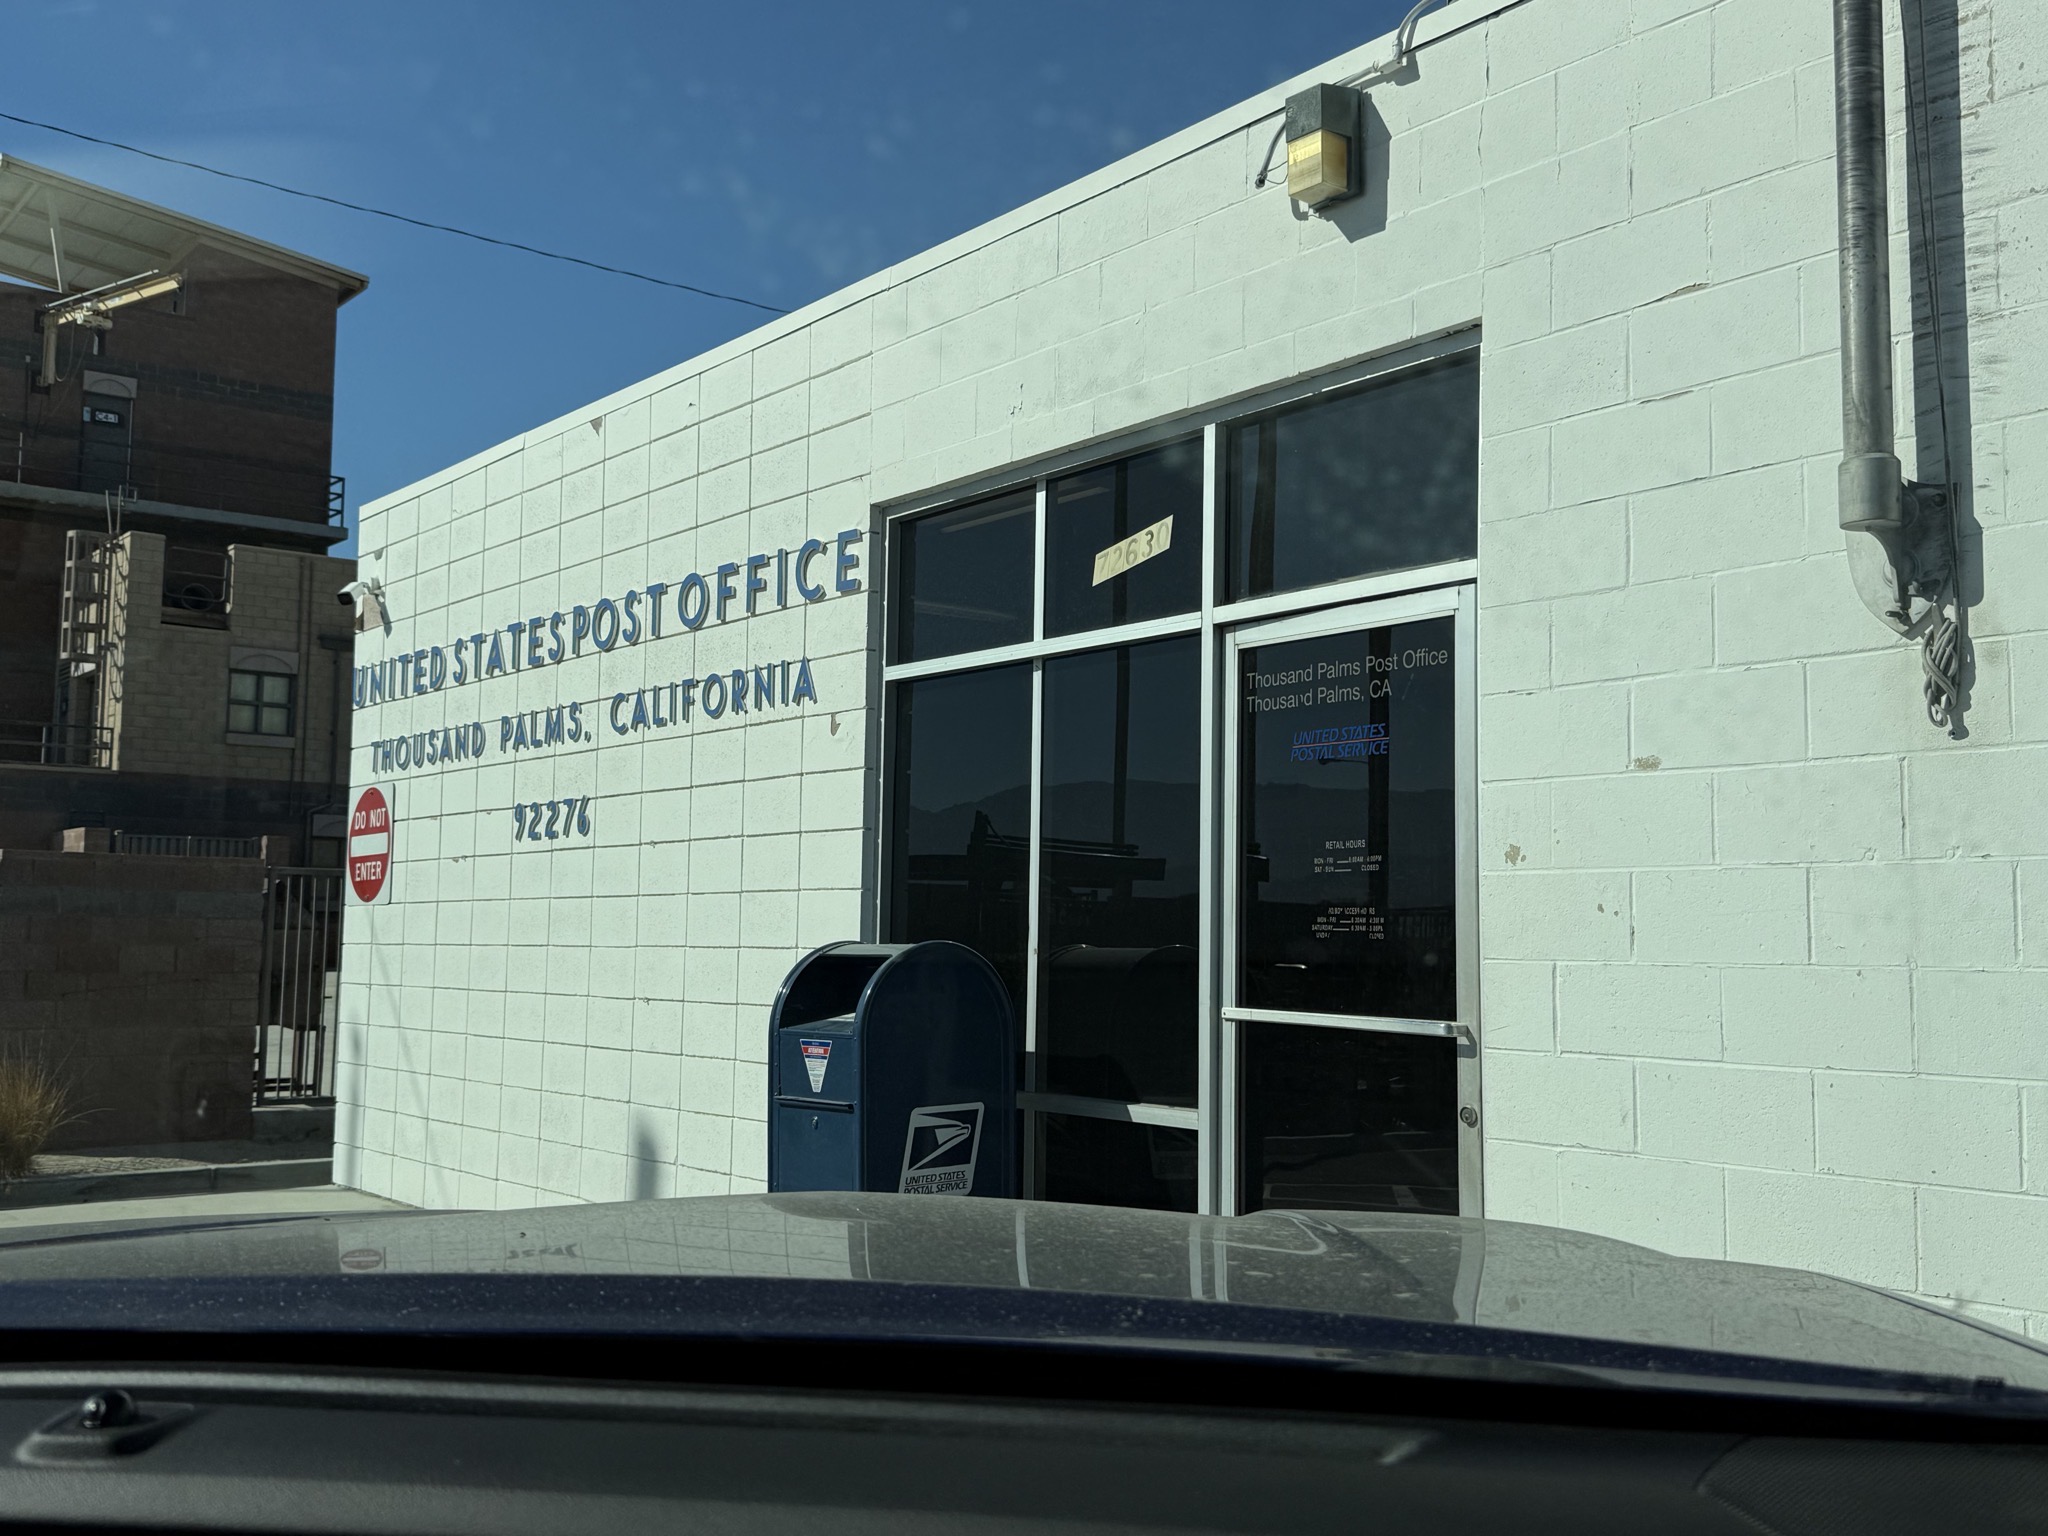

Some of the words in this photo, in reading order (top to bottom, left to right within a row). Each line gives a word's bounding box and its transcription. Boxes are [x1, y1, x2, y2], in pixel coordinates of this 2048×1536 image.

[353, 645, 447, 709] UNITED
[452, 611, 566, 685] STATES
[571, 582, 668, 652] POST
[677, 528, 863, 632] OFFICE
[1247, 663, 1313, 690] Thousand
[1317, 660, 1361, 680] Palms
[1365, 653, 1399, 674] Post
[1402, 647, 1449, 669] Office
[1247, 688, 1313, 713] Thousand
[1317, 685, 1365, 704] Palms,
[1369, 678, 1393, 699] CA
[371, 721, 486, 775] THOUSAND
[500, 701, 592, 754] PALMS,
[609, 655, 819, 735] CALIFORNIA
[1293, 728, 1339, 746] UNITED
[1340, 723, 1387, 741] STATES
[1290, 746, 1335, 763] POSTAL
[1338, 740, 1390, 758] SERVICE
[354, 810, 367, 831] DO
[369, 807, 387, 829] NOT
[513, 795, 591, 843] 92276
[1325, 841, 1345, 850] RETAIL
[1345, 839, 1366, 849] HOURS
[354, 860, 383, 882] ENTER
[903, 1184, 935, 1195] POSTAL
[935, 1180, 969, 1194] SERVICE
[905, 1173, 938, 1185] UNITED
[937, 1170, 966, 1182] STATES
